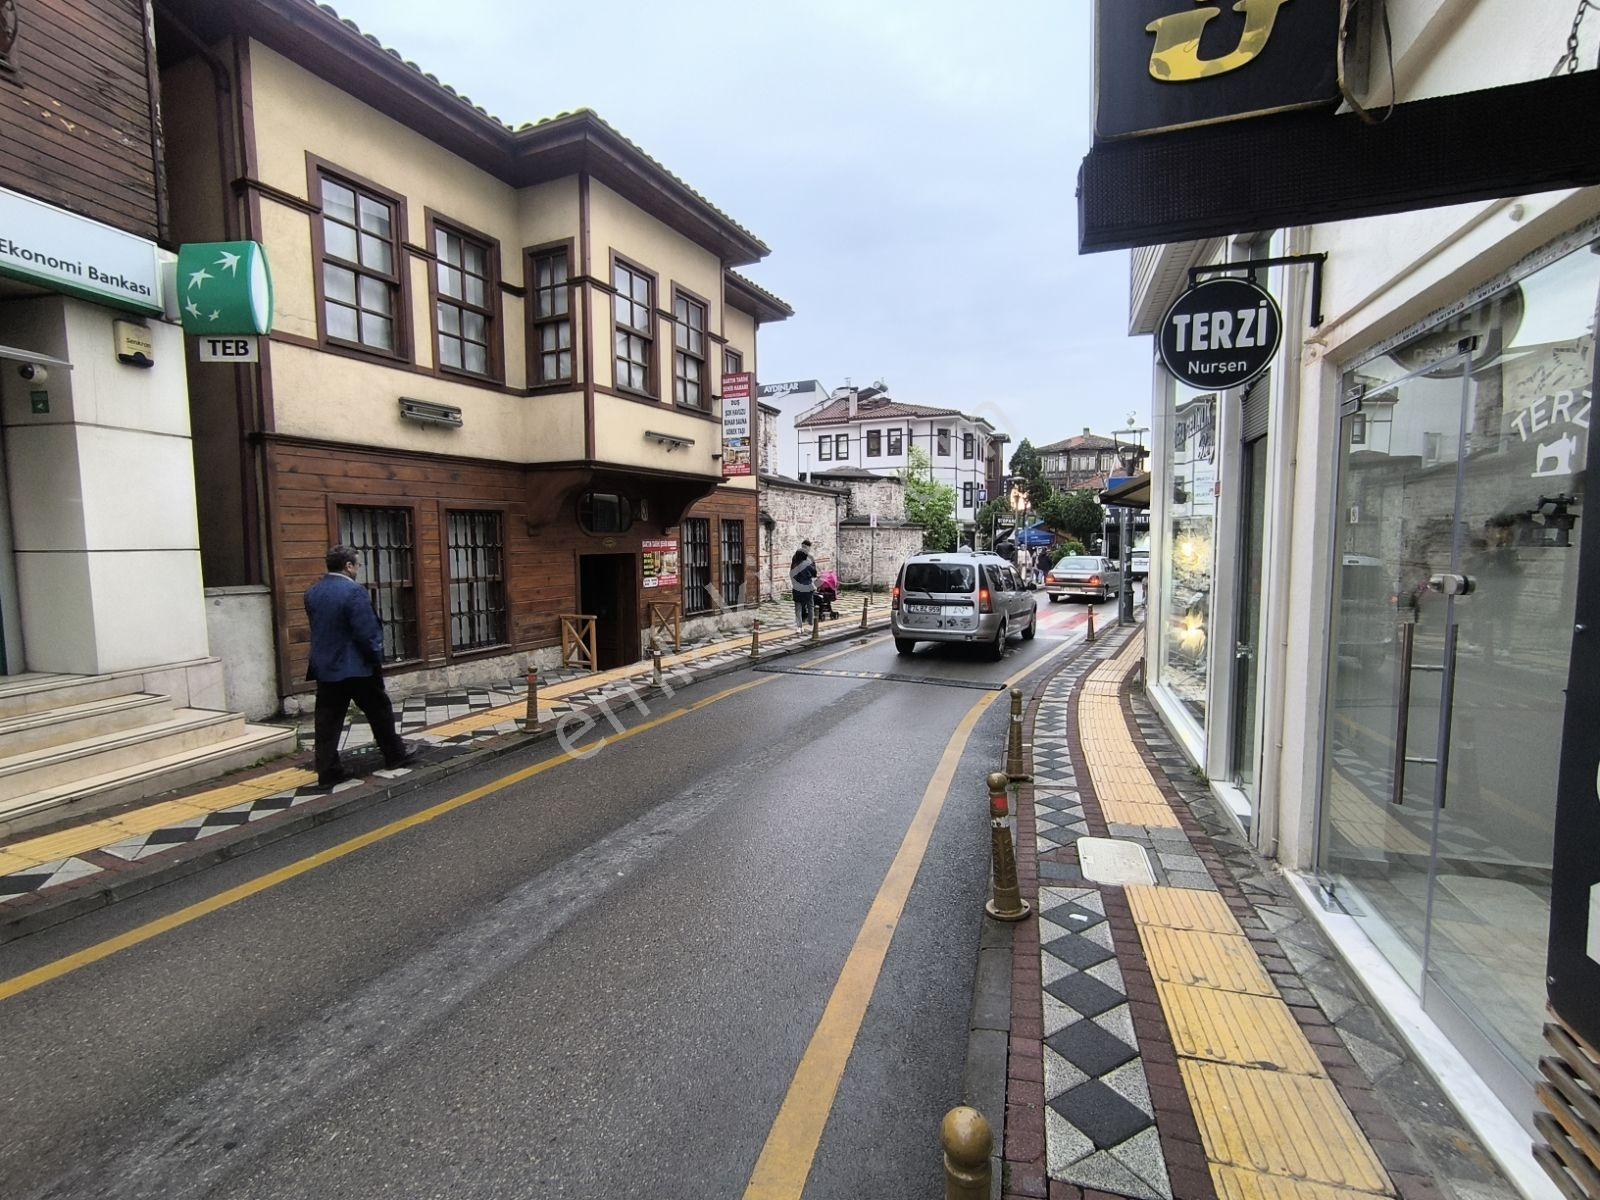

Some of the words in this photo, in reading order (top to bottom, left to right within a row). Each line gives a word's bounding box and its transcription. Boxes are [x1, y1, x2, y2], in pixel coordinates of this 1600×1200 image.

[0, 238, 82, 276] Ekonomi
[88, 266, 151, 296] Bankası
[1172, 299, 1268, 352] TERZİ
[207, 339, 250, 356] TEB
[1188, 360, 1247, 375] Nurşen
[764, 382, 799, 393] AYDINLAR
